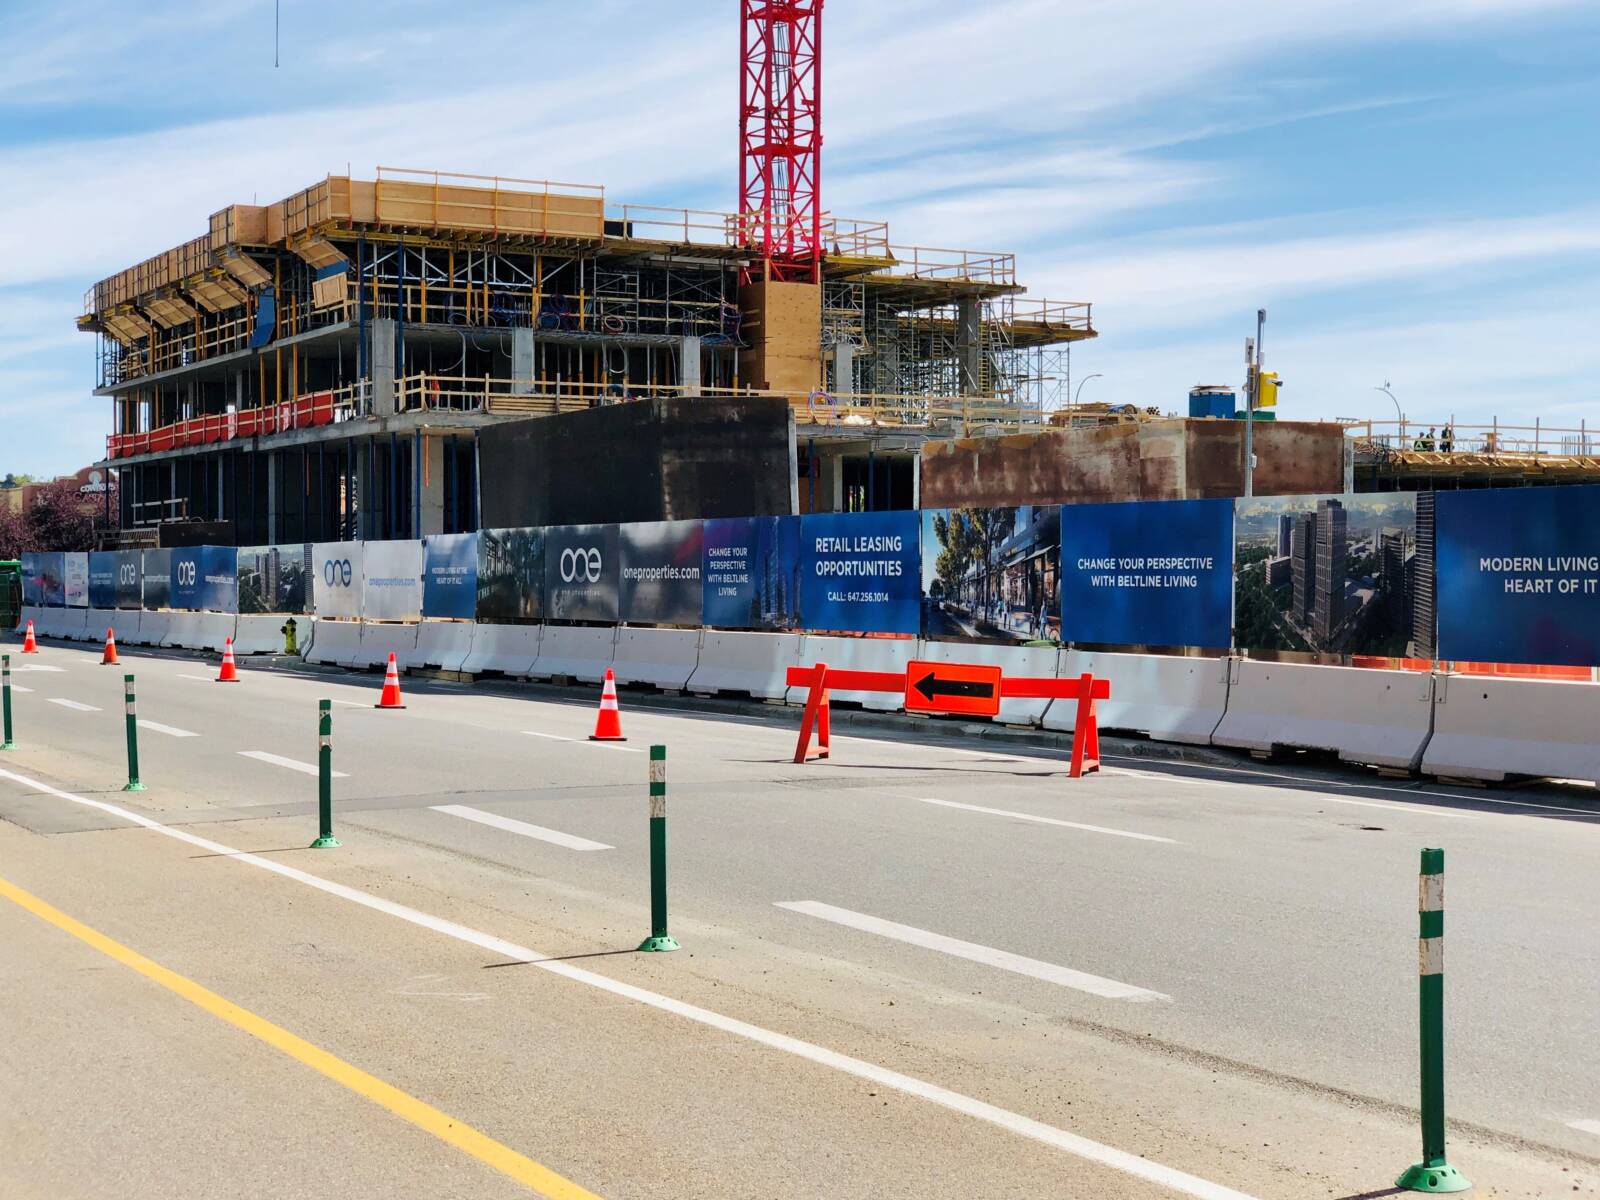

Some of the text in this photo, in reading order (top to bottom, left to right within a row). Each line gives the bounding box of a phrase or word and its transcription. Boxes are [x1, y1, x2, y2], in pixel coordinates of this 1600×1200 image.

[815, 536, 902, 553] RETAIL LEASING
[708, 547, 748, 557] CHANGE YOUR
[709, 560, 746, 570] PERSPECTIVE
[815, 560, 903, 576] OPPORTUNITIES
[1077, 557, 1213, 570] CHANGE YOUR PERSPECTIVE
[1480, 557, 1599, 571] MODERN LIVING
[623, 564, 700, 581] oneproperties.com
[707, 574, 749, 583] WITH BELTLINE
[1091, 575, 1198, 587] WITH BELTLINE LIVING
[1504, 579, 1598, 593] HEART OF IT
[718, 587, 737, 596] LIVING
[827, 591, 889, 602] CALL: 647.256.1014
